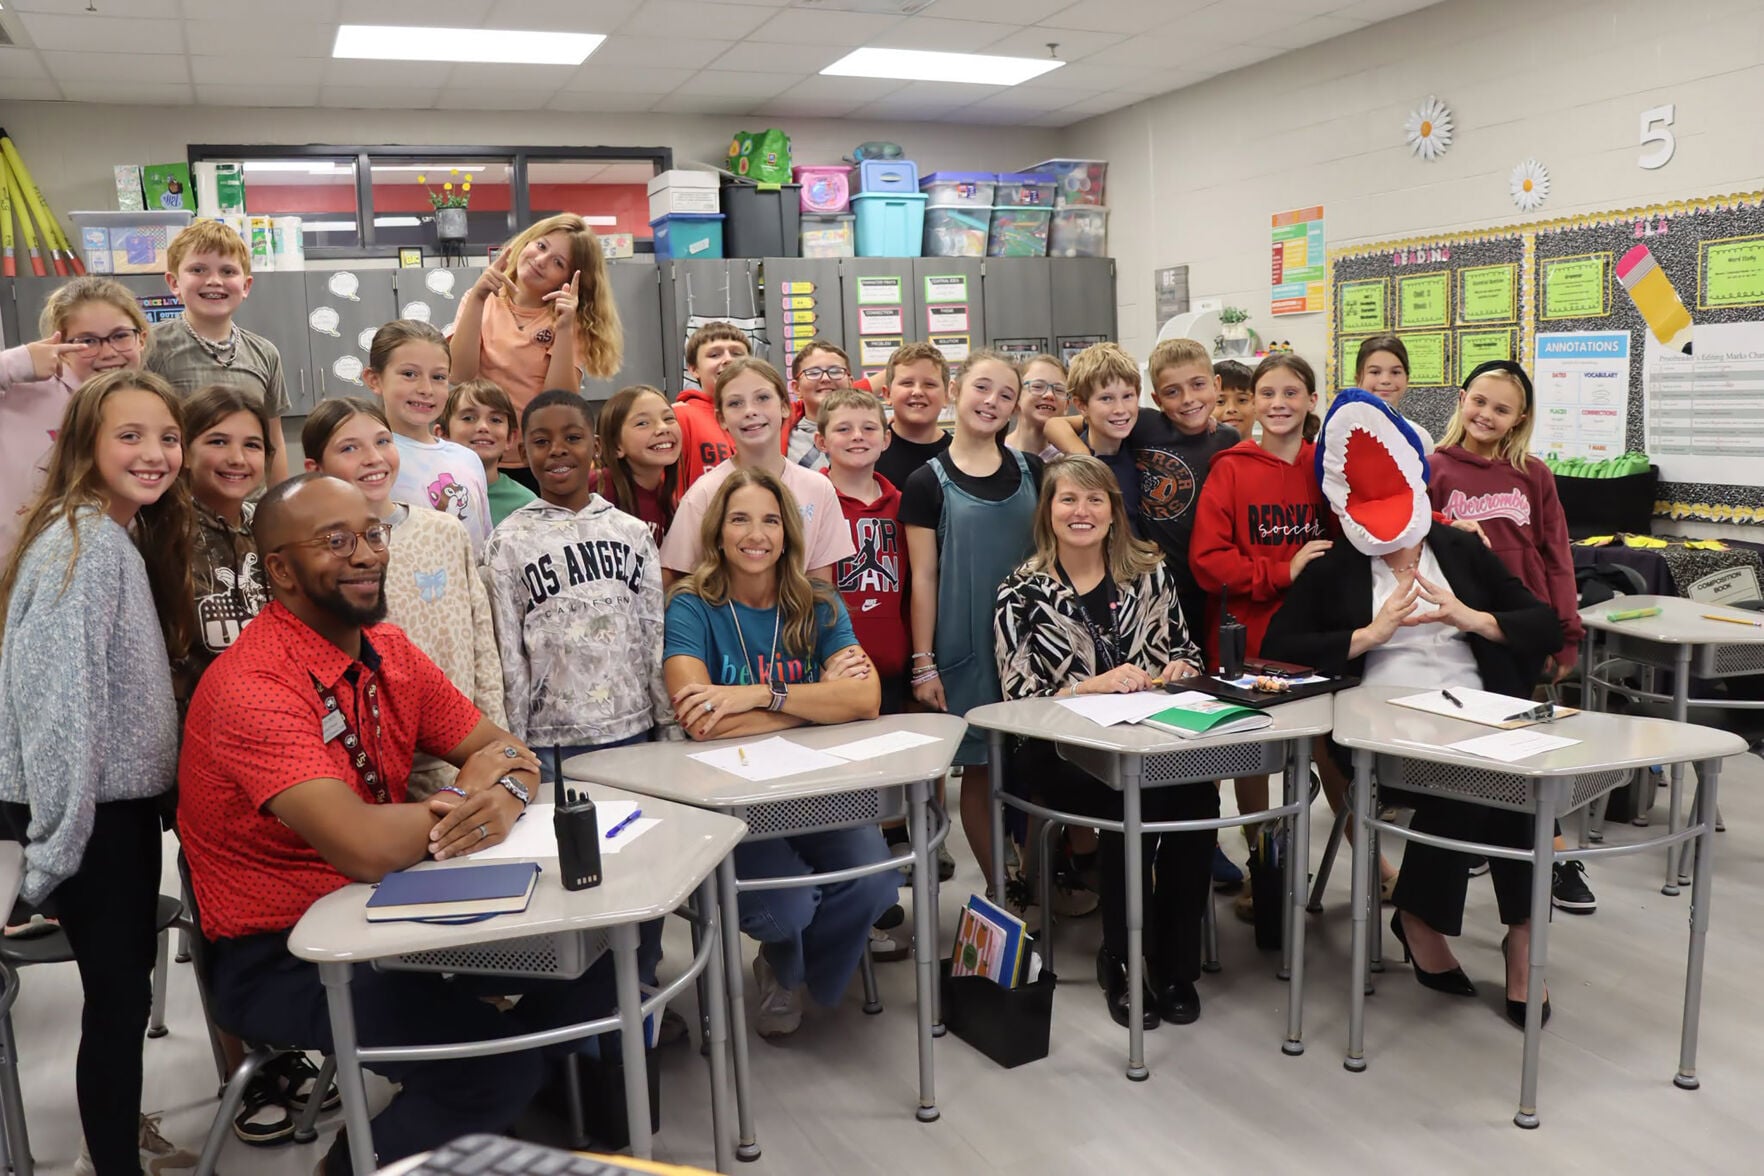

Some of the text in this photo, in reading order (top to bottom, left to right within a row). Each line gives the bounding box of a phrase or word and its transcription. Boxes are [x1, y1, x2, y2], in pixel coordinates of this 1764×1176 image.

[1638, 104, 1676, 170] 5
[1393, 247, 1451, 267] READING
[1545, 340, 1619, 353] ANNOTATIONS
[1726, 352, 1747, 360] Marks
[845, 518, 898, 554] OR
[1258, 518, 1326, 538] soccer
[563, 540, 645, 595] ANGELE
[1697, 571, 1742, 591] COMPOSITION
[1713, 582, 1732, 593] BOOK
[544, 596, 630, 618] CALIFORN
[721, 654, 750, 686] be
